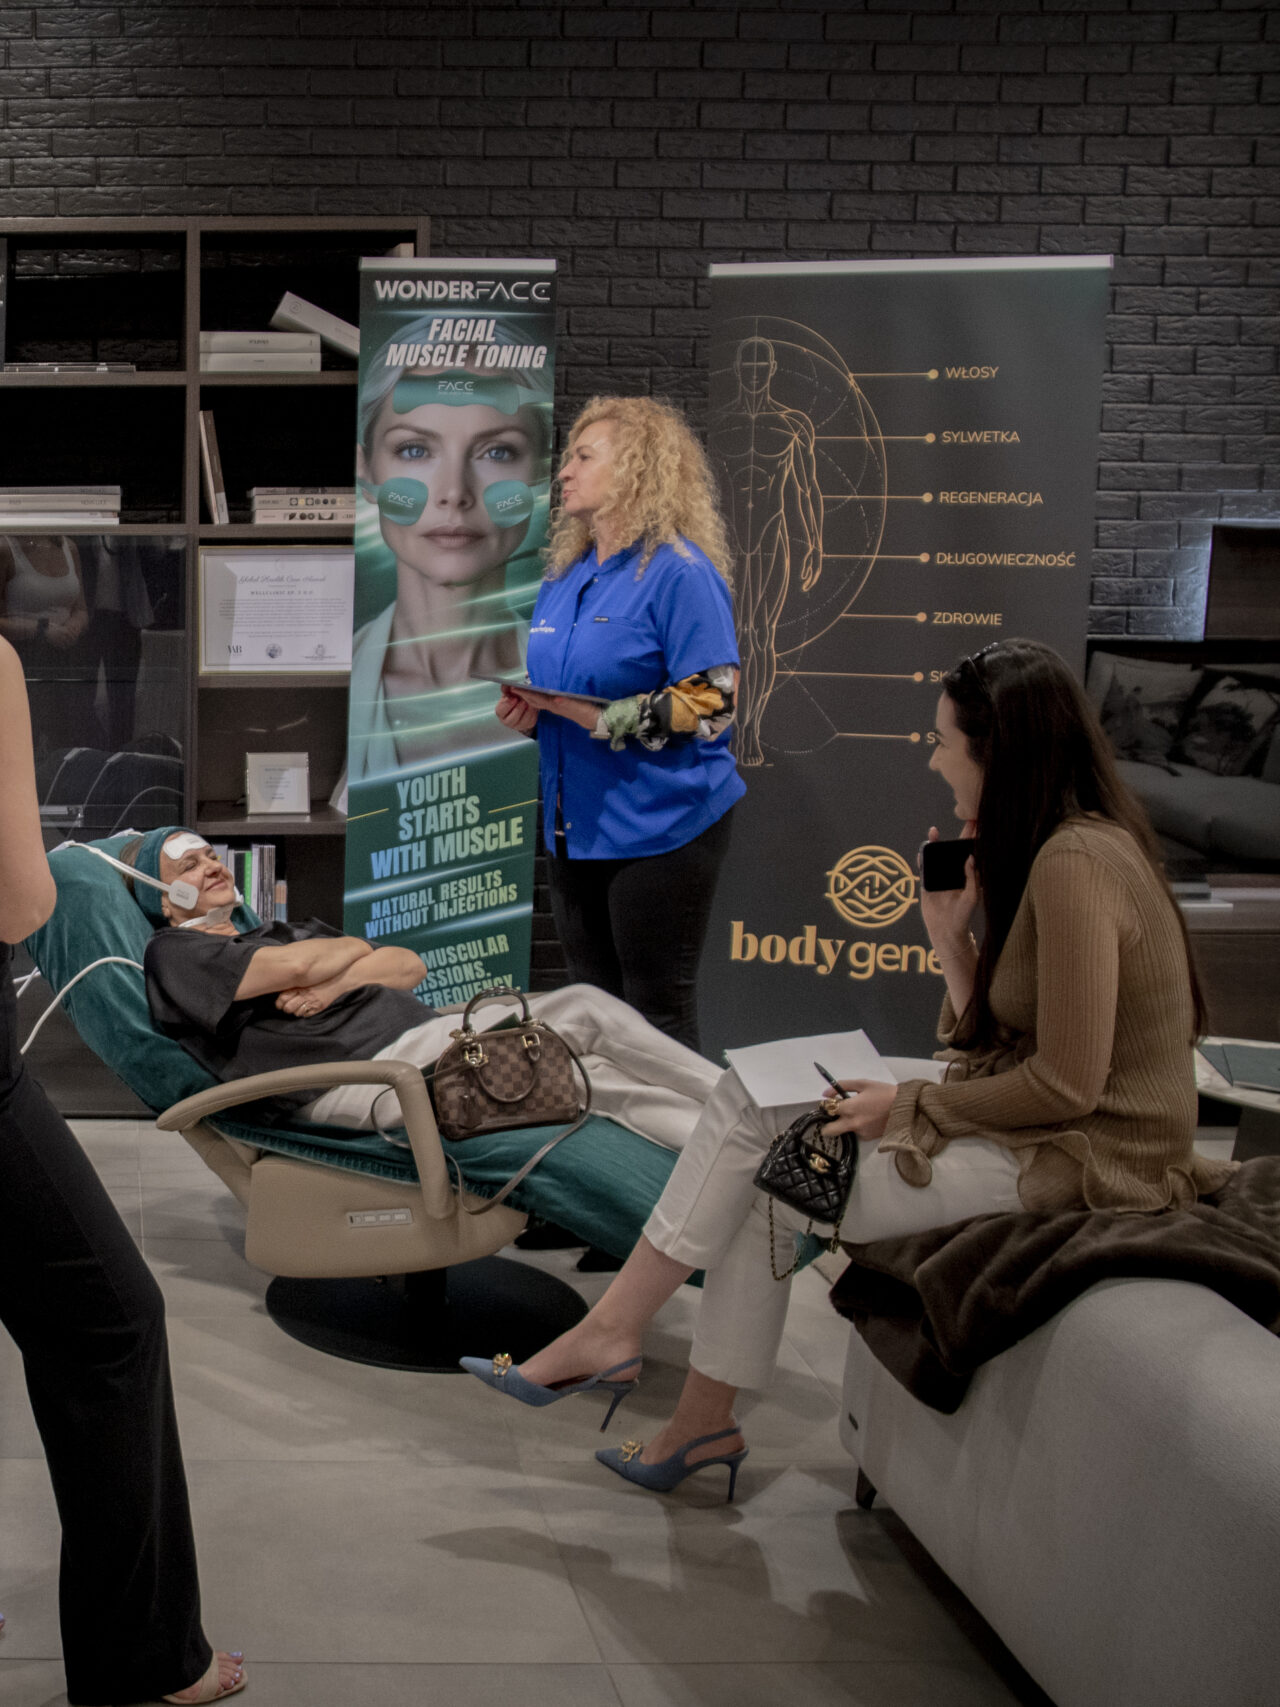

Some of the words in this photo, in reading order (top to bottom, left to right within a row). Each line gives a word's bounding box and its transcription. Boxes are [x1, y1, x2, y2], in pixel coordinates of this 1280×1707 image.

[428, 318, 497, 343] FACIAL
[385, 343, 469, 367] MUSCLE
[474, 345, 547, 368] TONING
[945, 366, 999, 379] WŁOSY
[942, 431, 1020, 444] SYLWETKA
[939, 490, 1044, 507] REGENERACJA
[936, 550, 1076, 567] DŁUGOWIECZNOŚĆ
[932, 611, 1003, 626] ZDROWIE
[396, 766, 467, 809] YOUTH
[398, 795, 481, 841] STARTS
[371, 841, 427, 880] WITH
[433, 816, 524, 865] MUSCLE
[372, 887, 436, 920] NATURAL
[440, 869, 503, 901] RESULTS
[365, 907, 429, 939] WITHOUT
[434, 883, 518, 921] INJECTIONS
[419, 934, 510, 970] MUSCULAR
